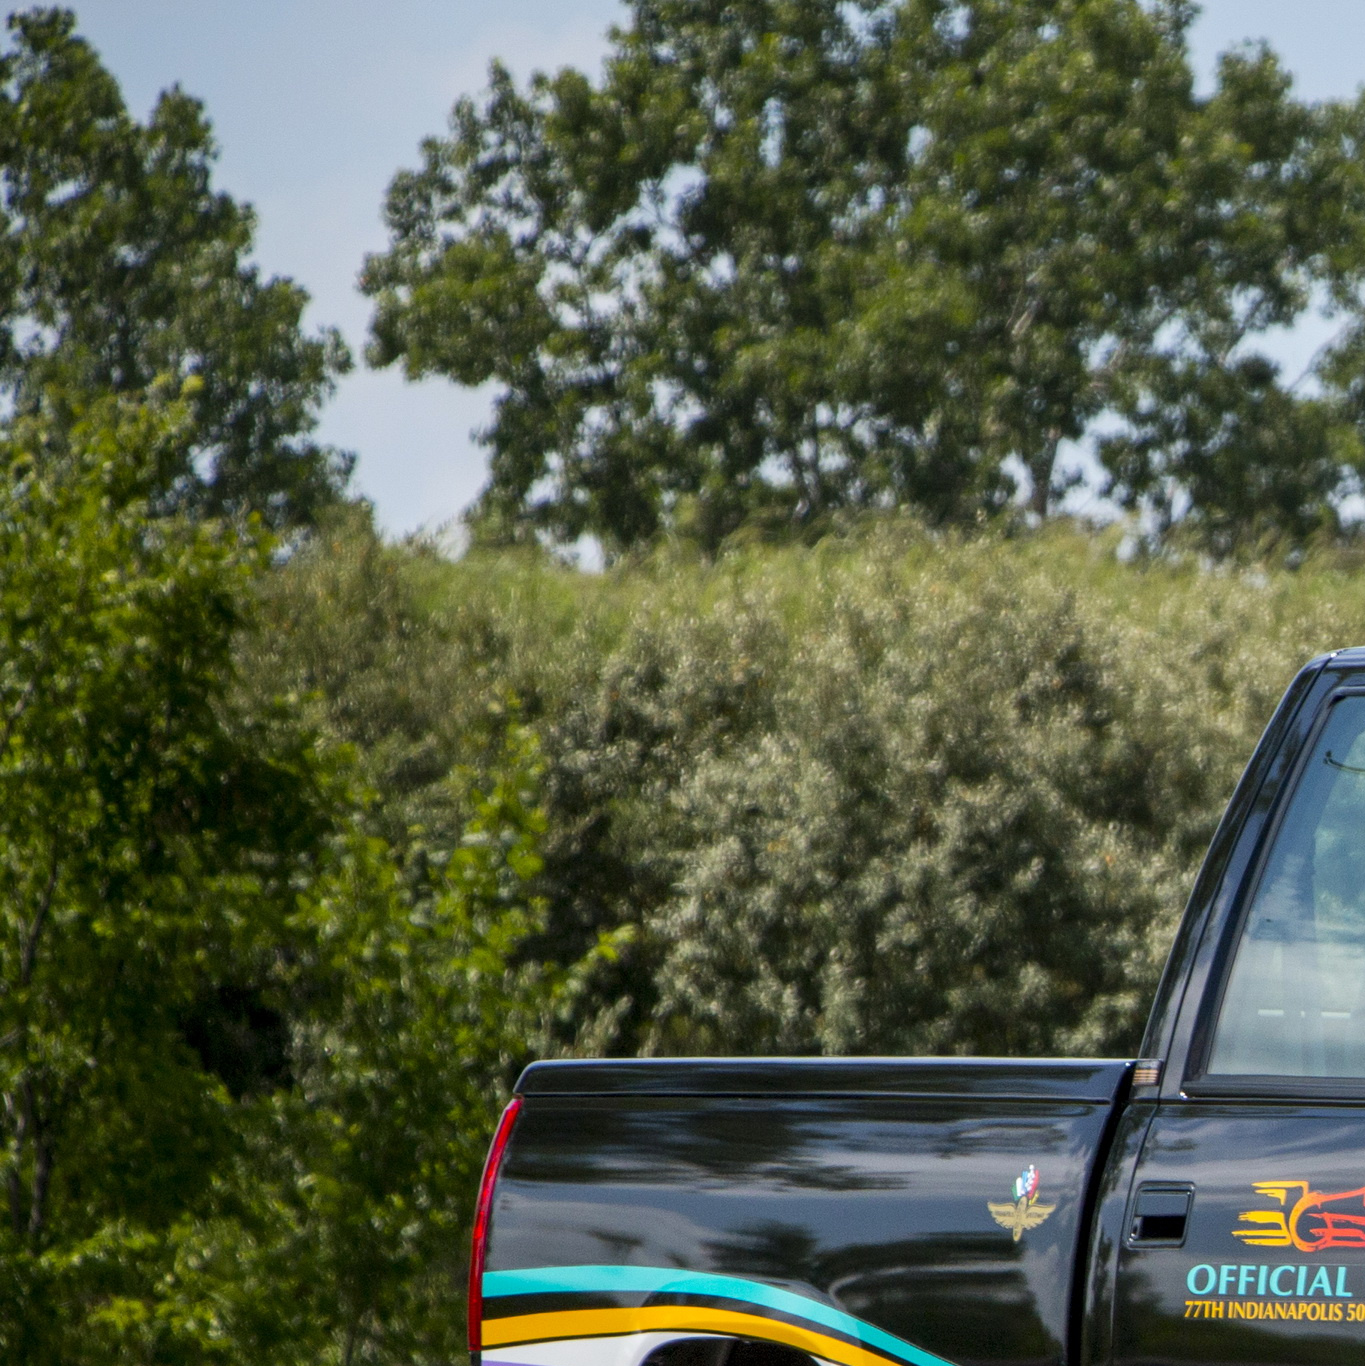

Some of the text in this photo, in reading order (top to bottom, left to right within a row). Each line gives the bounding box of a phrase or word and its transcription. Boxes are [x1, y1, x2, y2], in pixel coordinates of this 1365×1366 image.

[1186, 1263, 1353, 1298] OFFICIAL
[1184, 1300, 1225, 1319] 77TH
[1228, 1301, 1344, 1322] INDIANAPOLIS
